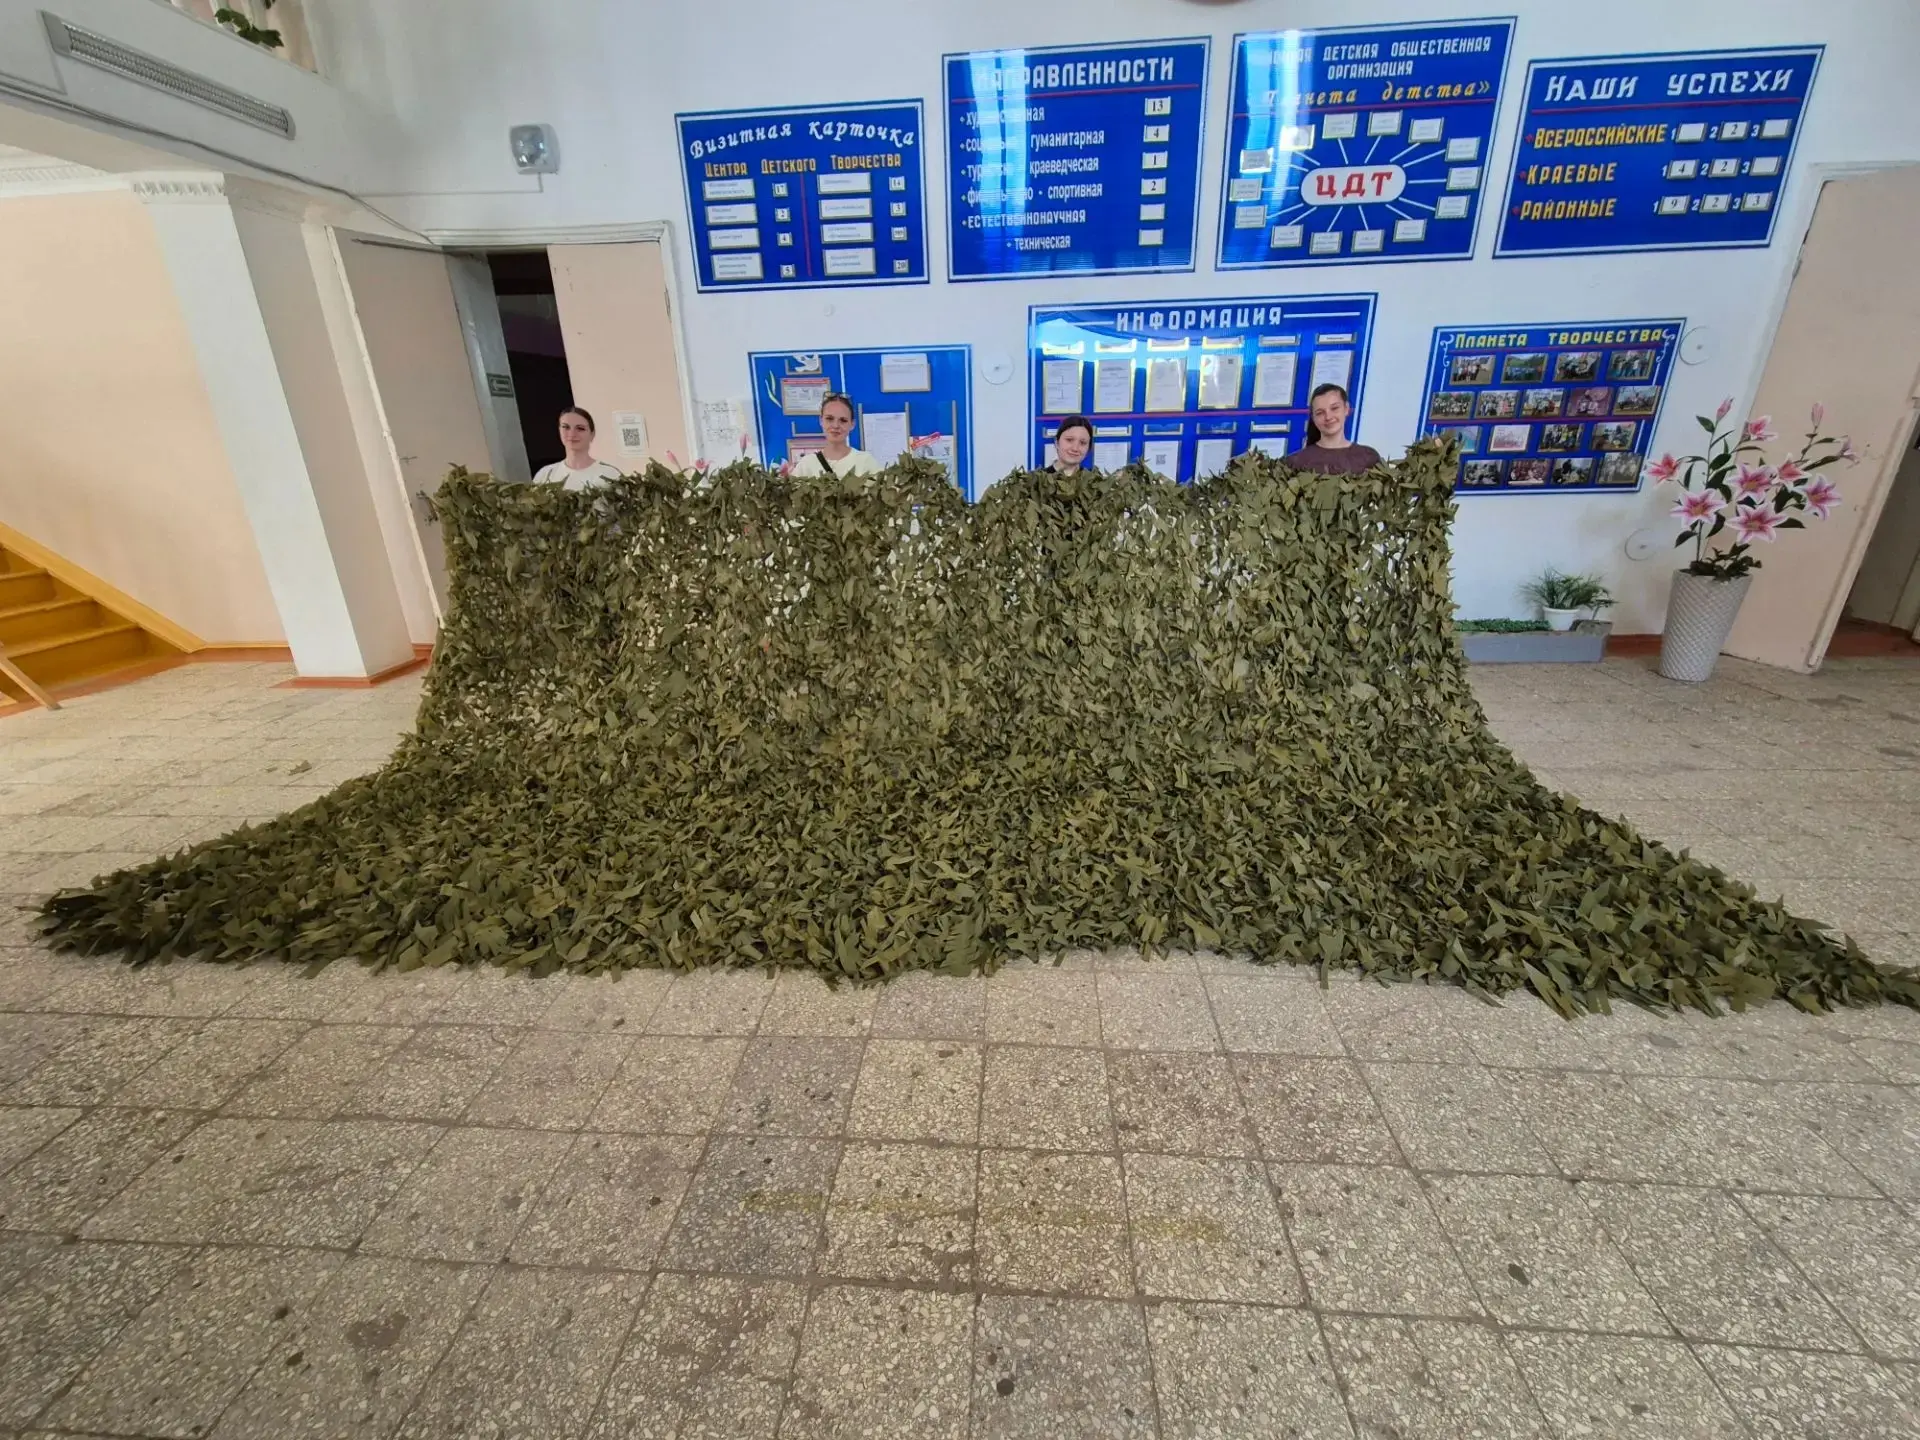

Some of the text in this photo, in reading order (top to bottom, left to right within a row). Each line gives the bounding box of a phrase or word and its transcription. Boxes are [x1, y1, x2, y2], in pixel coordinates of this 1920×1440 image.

[1323, 44, 1379, 62] ДЕТСКАЯ
[1391, 37, 1492, 57] ОБЩЕСТВЕННАЯ
[976, 57, 1175, 92] АРАВЛЕННОСТИ
[1327, 61, 1413, 80] ОРГАНИЗАЦИЯ
[1382, 80, 1490, 101] детства»
[1667, 68, 1794, 97] УСПЕХИ
[1151, 100, 1164, 113] 13
[689, 122, 792, 159] Визитная
[1030, 130, 1105, 149] гуманитарная
[1153, 128, 1160, 138] 4
[1533, 121, 1668, 149] ВСЕРОССИЙСКИЕ
[1709, 126, 1719, 139] 2
[1730, 124, 1738, 135] 2
[1751, 124, 1760, 138] 3
[1029, 156, 1099, 178] краеведческая
[1526, 162, 1617, 185] КРАЕВЫЕ
[1679, 163, 1686, 174] 4
[1700, 163, 1710, 176] 2
[1720, 161, 1729, 172] 2
[1741, 161, 1751, 174] 3
[1047, 183, 1103, 202] спортивная
[1150, 181, 1158, 191] 2
[1316, 171, 1393, 198] ЦДТ
[967, 209, 1087, 229] ЕСТЕСТВЕННОНАУЧНАЯ
[1519, 196, 1617, 220] РАЙОННЫЕ
[1671, 199, 1678, 209] 9
[1692, 199, 1701, 211] 2
[1711, 197, 1720, 208] 2
[1733, 197, 1741, 210] 3
[1752, 196, 1761, 207] 3
[1014, 235, 1072, 251] техническая
[1116, 307, 1282, 332] ИНФОРМАЦИЯ
[1547, 328, 1664, 346] ТВОРЧЕСТВА
